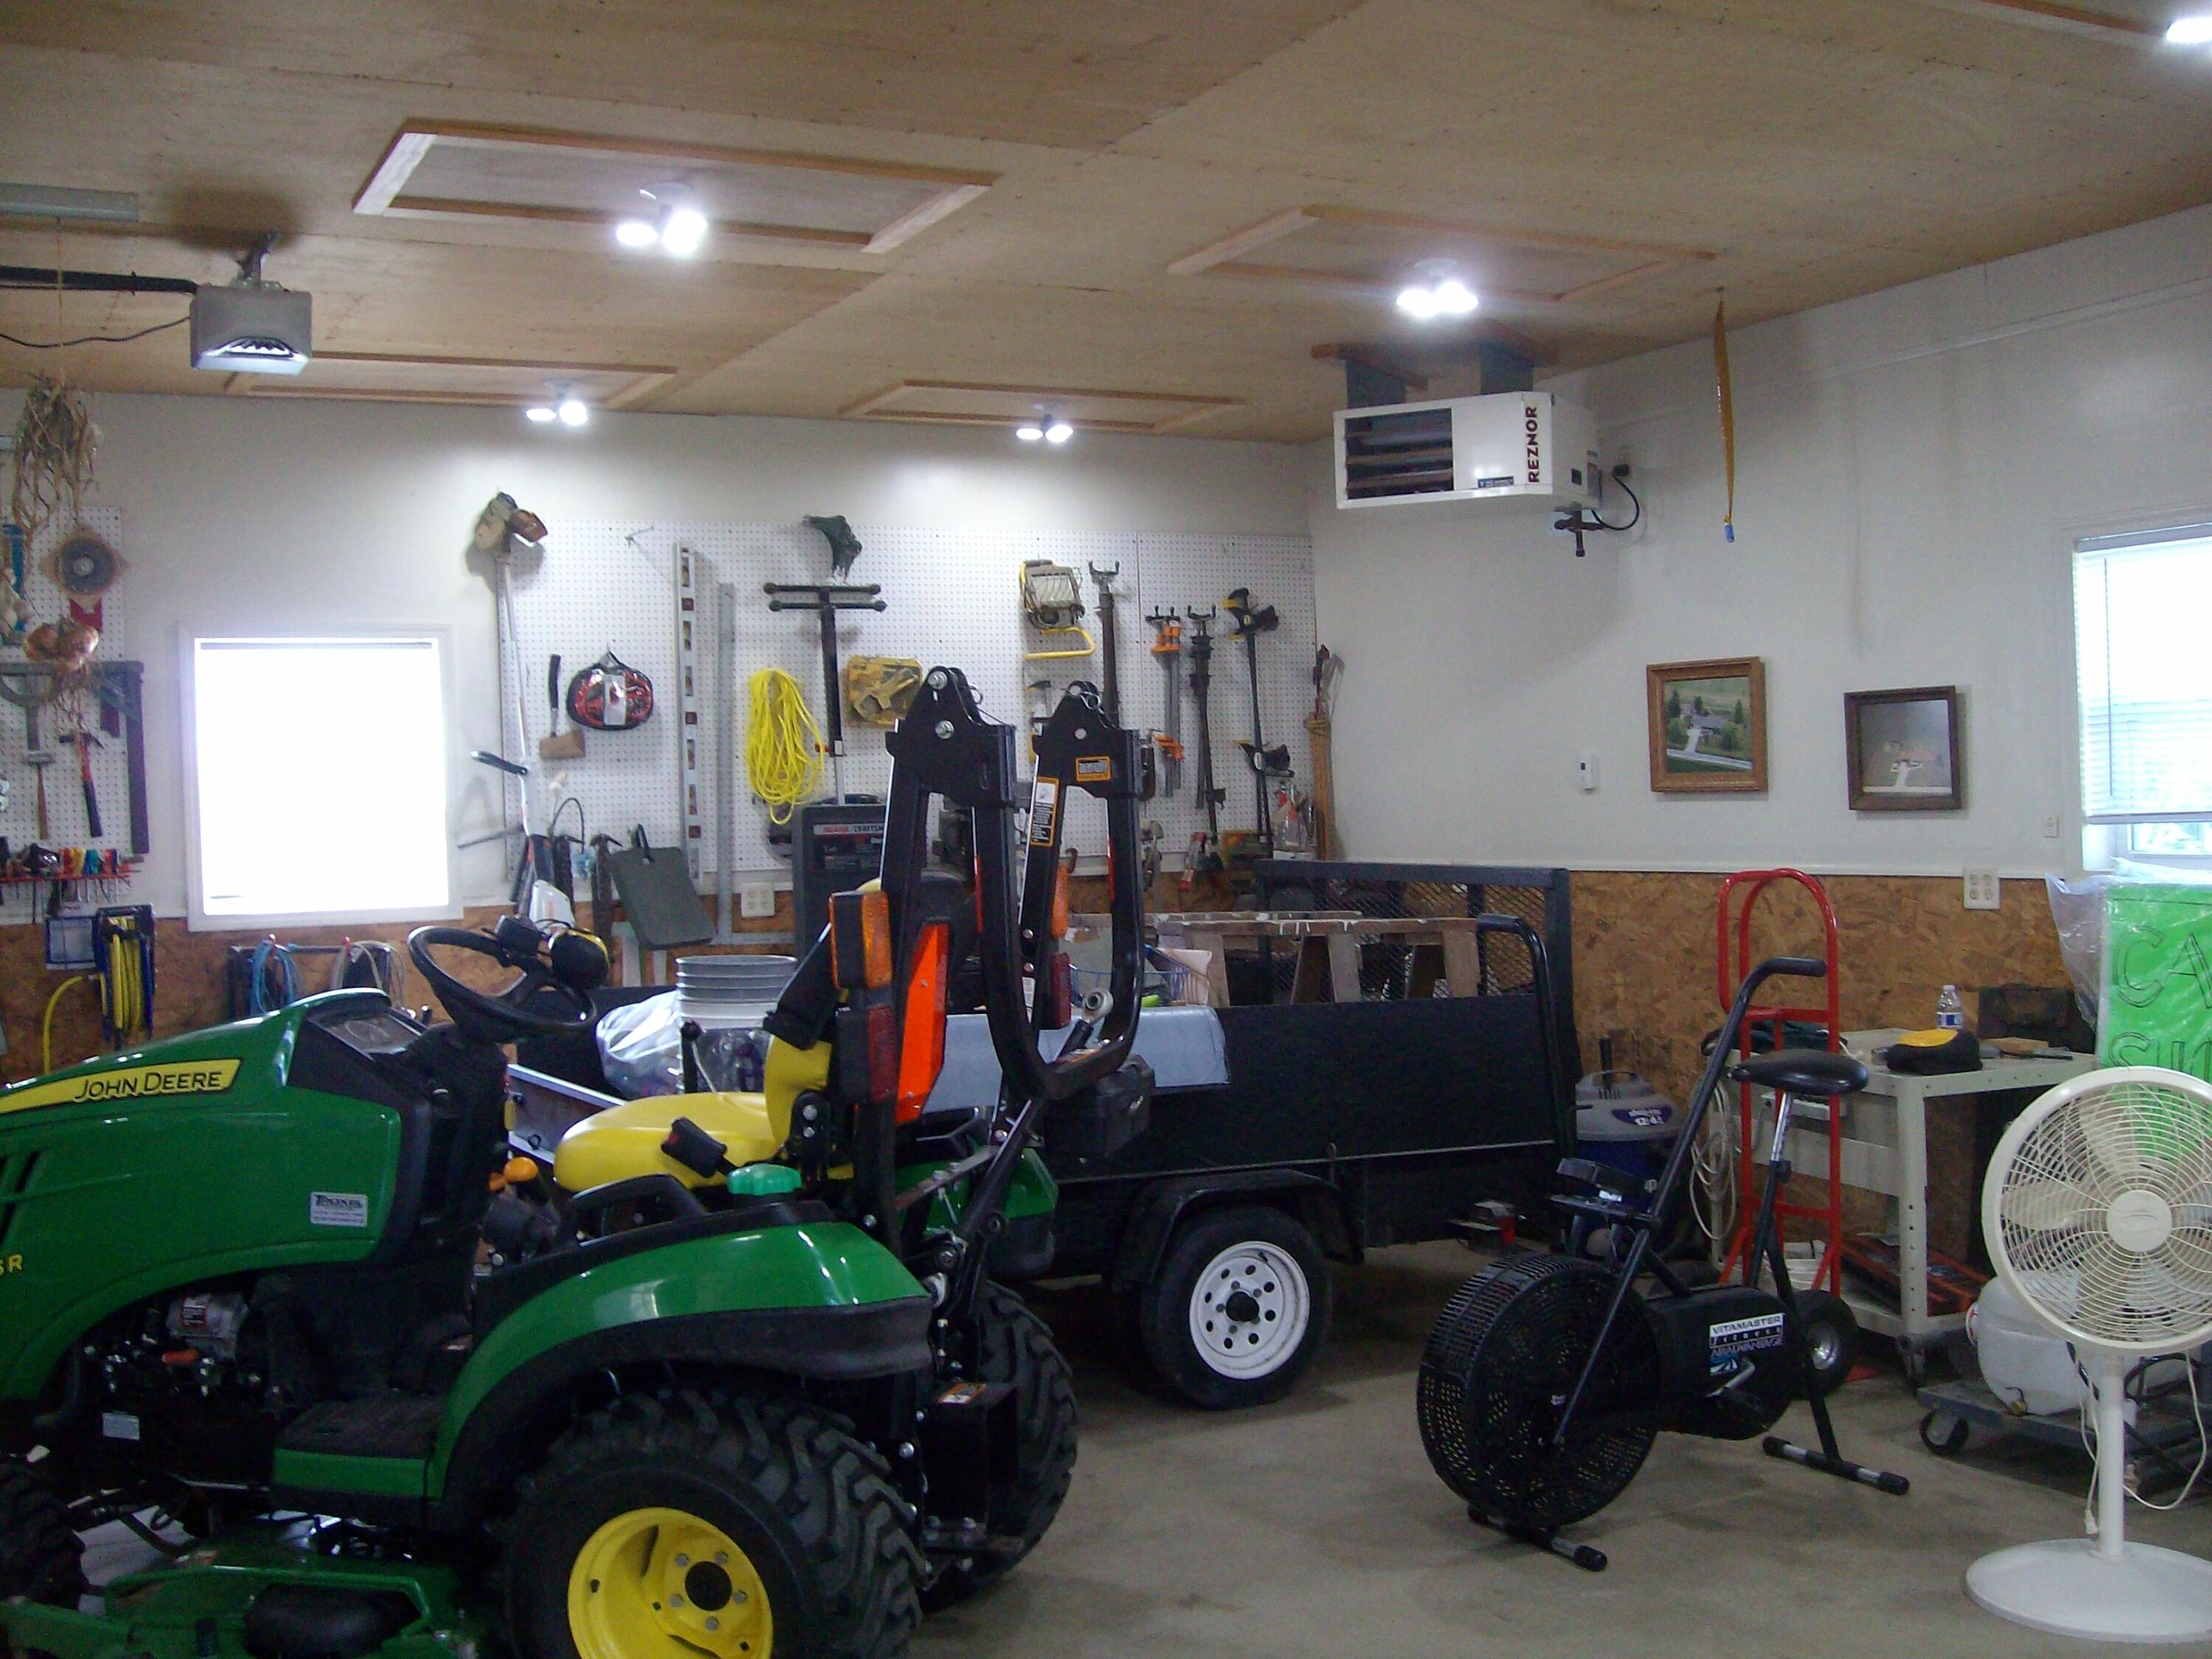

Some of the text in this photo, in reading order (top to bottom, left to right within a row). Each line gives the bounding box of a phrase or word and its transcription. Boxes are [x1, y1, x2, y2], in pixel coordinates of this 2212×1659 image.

[1525, 406, 1540, 483] REZNOR
[74, 1071, 223, 1099] JOHN DEERE
